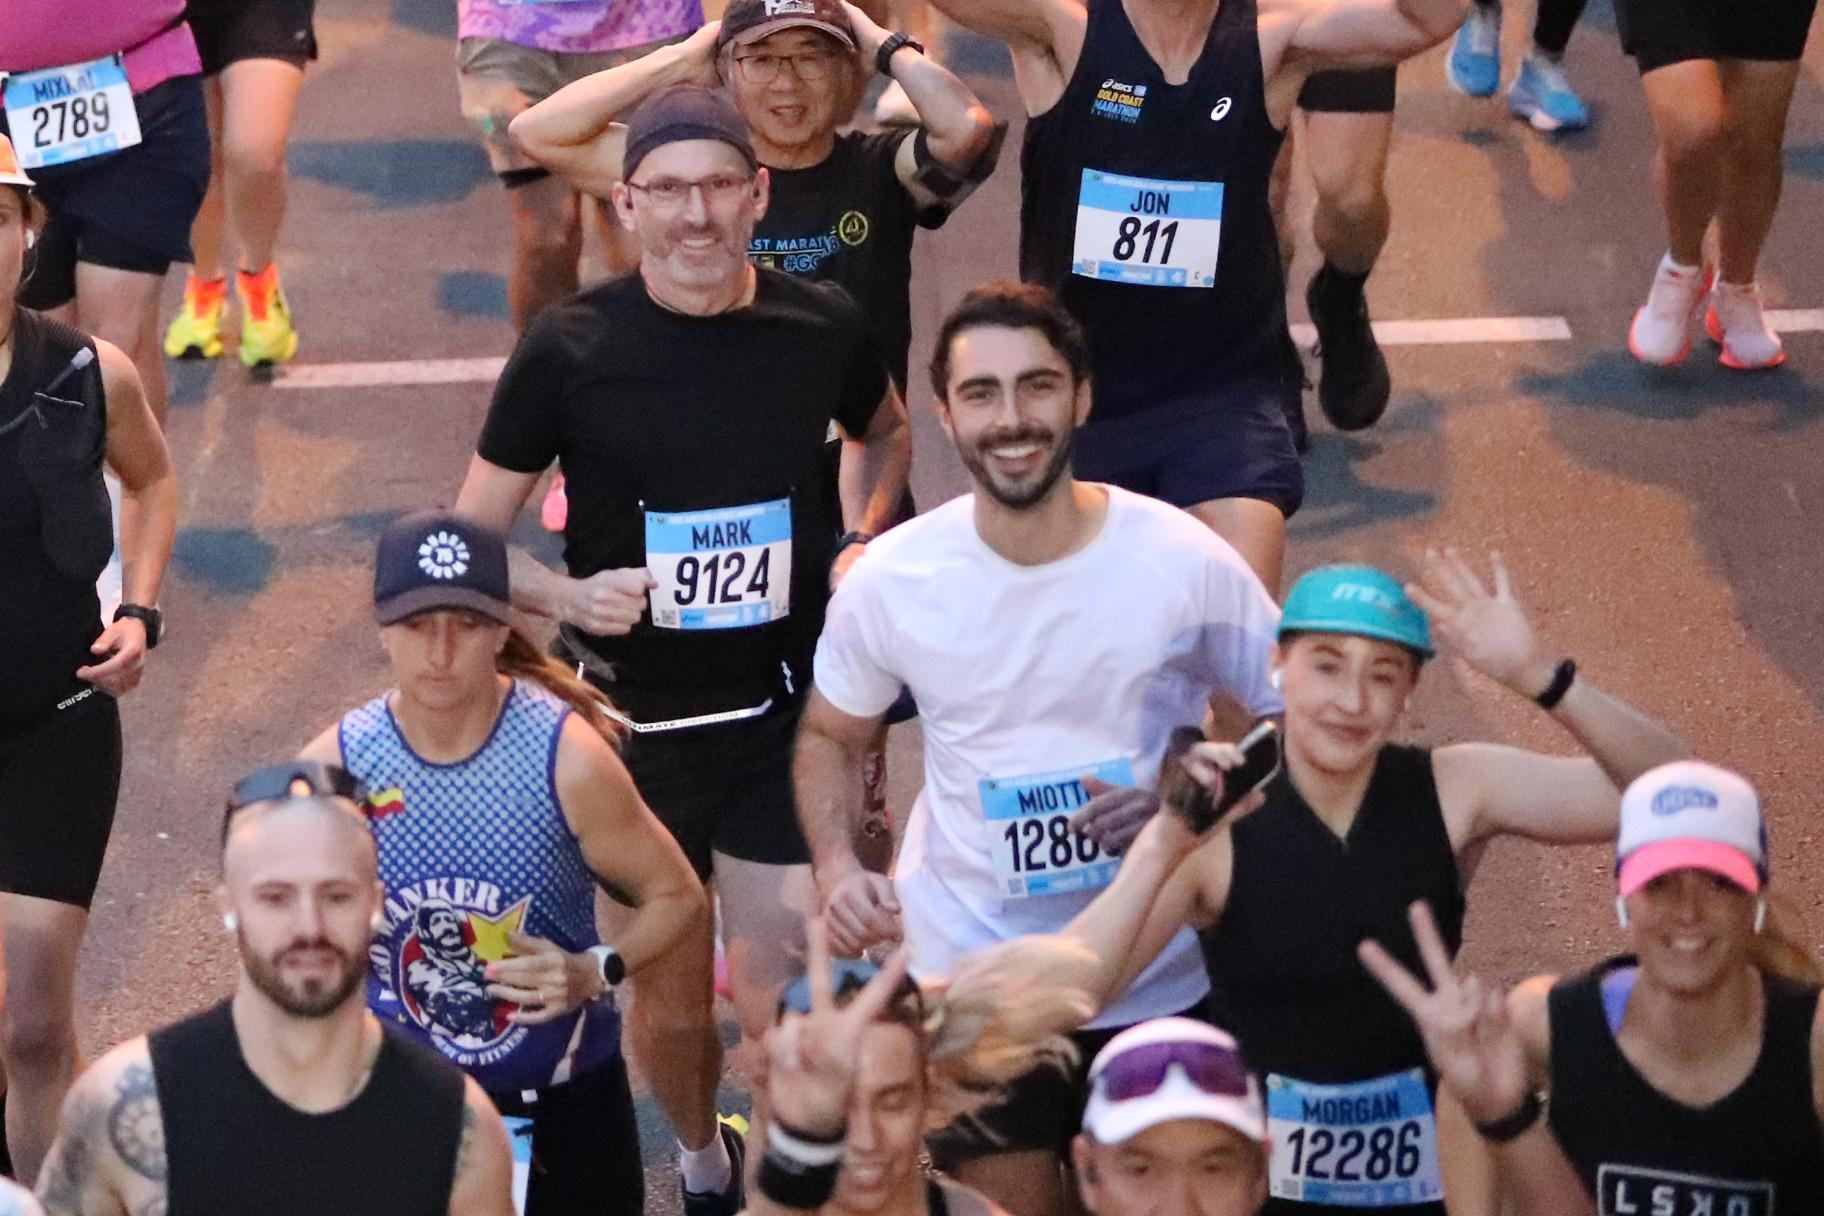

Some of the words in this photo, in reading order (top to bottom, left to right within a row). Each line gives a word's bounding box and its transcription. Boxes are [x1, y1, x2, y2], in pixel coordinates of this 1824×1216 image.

[1095, 99, 1142, 118] MARATHON
[1117, 93, 1145, 107] COAST
[33, 91, 110, 148] 2789
[1129, 191, 1171, 215] JON
[775, 236, 826, 251] MARAT
[1112, 216, 1180, 264] 811
[692, 519, 752, 550] MARK
[674, 547, 770, 606] 9124
[1302, 1092, 1400, 1126] MORGAN
[1287, 1121, 1421, 1182] 12286
